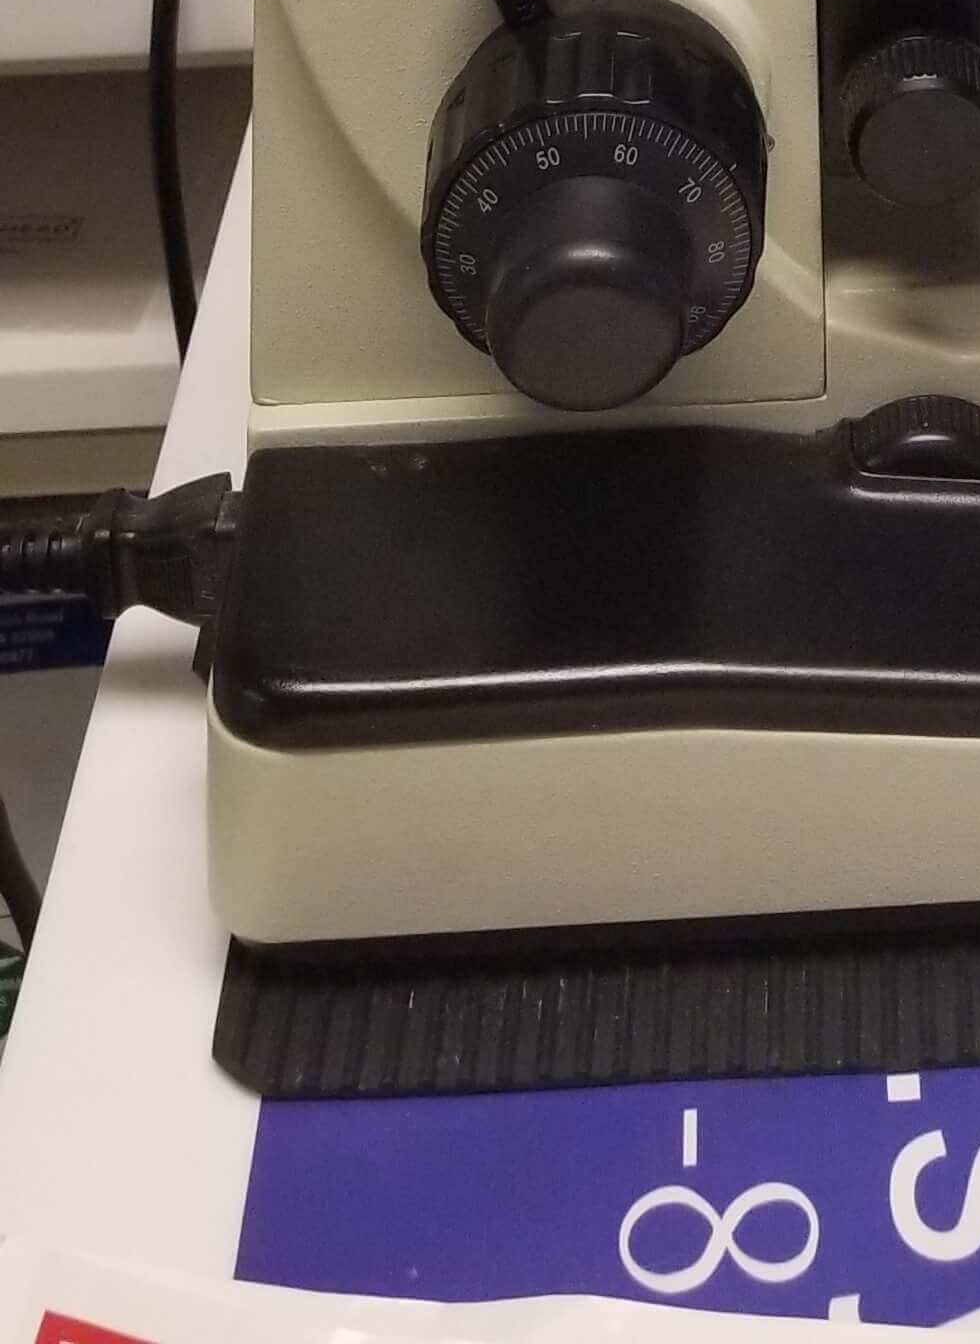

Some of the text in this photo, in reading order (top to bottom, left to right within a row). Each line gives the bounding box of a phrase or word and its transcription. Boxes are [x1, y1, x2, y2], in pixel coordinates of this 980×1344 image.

[459, 253, 478, 276] 30
[477, 188, 500, 215] 40
[535, 146, 563, 172] 50
[613, 143, 640, 167] 60
[677, 179, 704, 206] 70
[706, 239, 726, 265] 80
